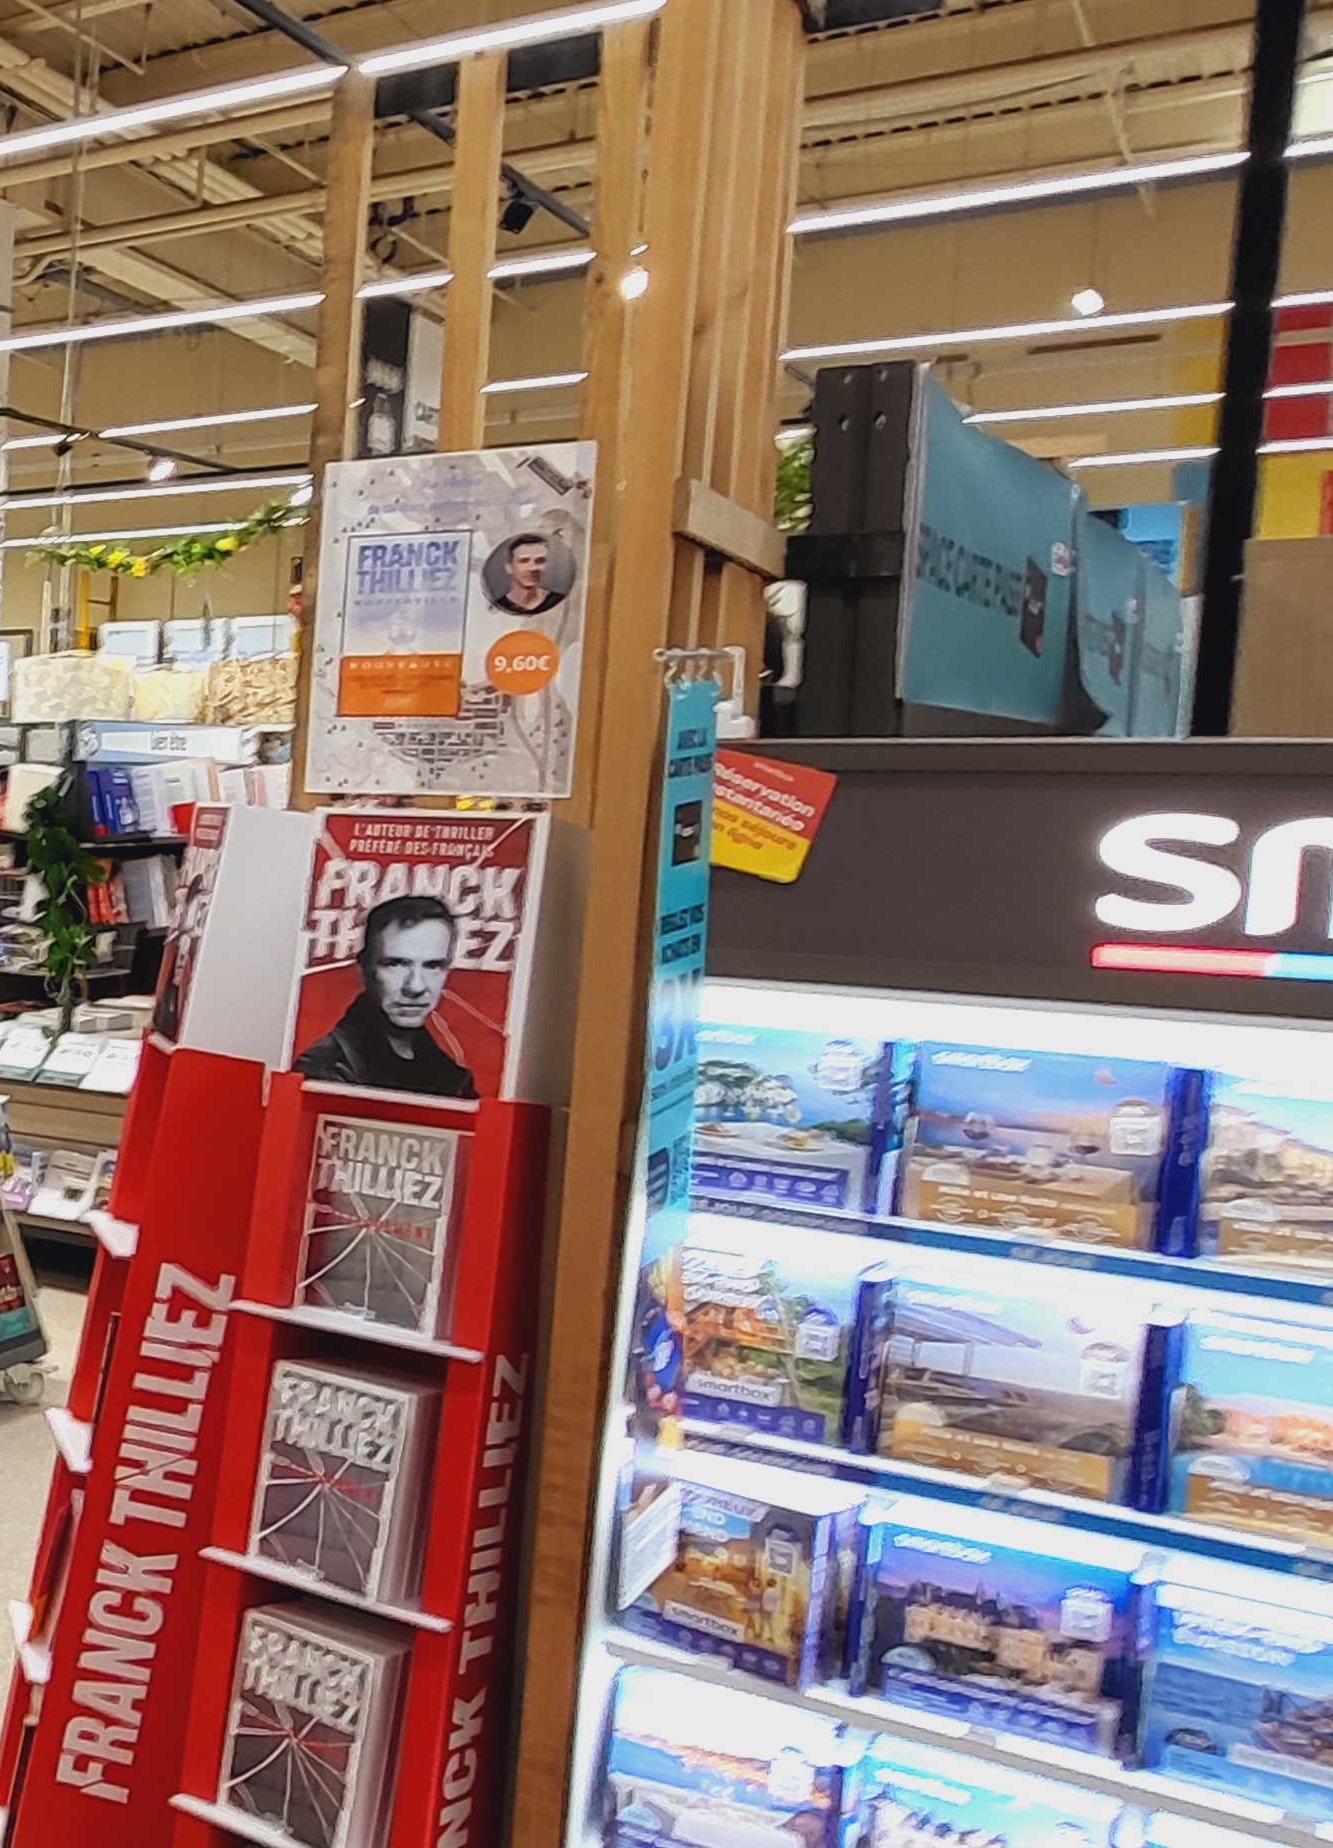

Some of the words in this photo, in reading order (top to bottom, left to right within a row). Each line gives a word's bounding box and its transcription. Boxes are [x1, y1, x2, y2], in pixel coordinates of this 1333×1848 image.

[358, 540, 459, 569] FRANCK
[356, 566, 458, 595] THILLIEZ
[494, 655, 552, 673] 9,60€
[714, 782, 805, 831] stantanée
[349, 839, 402, 854] PRÉFÉRÉ
[405, 842, 429, 855] DES
[354, 823, 411, 838] L'AUTEUR
[414, 824, 430, 839] DE
[433, 825, 495, 840] THRILLER
[316, 860, 525, 920] FRANCK
[307, 908, 517, 971] THEZ
[321, 1125, 445, 1175] FRANCK
[318, 1158, 443, 1209] THILLIEZ
[108, 1262, 235, 1529] THILLIEZ
[695, 1378, 773, 1402] smartbox
[459, 1353, 529, 1675] THILLIEZ
[670, 1604, 740, 1637] smartbox
[55, 1539, 180, 1805] FRANCK
